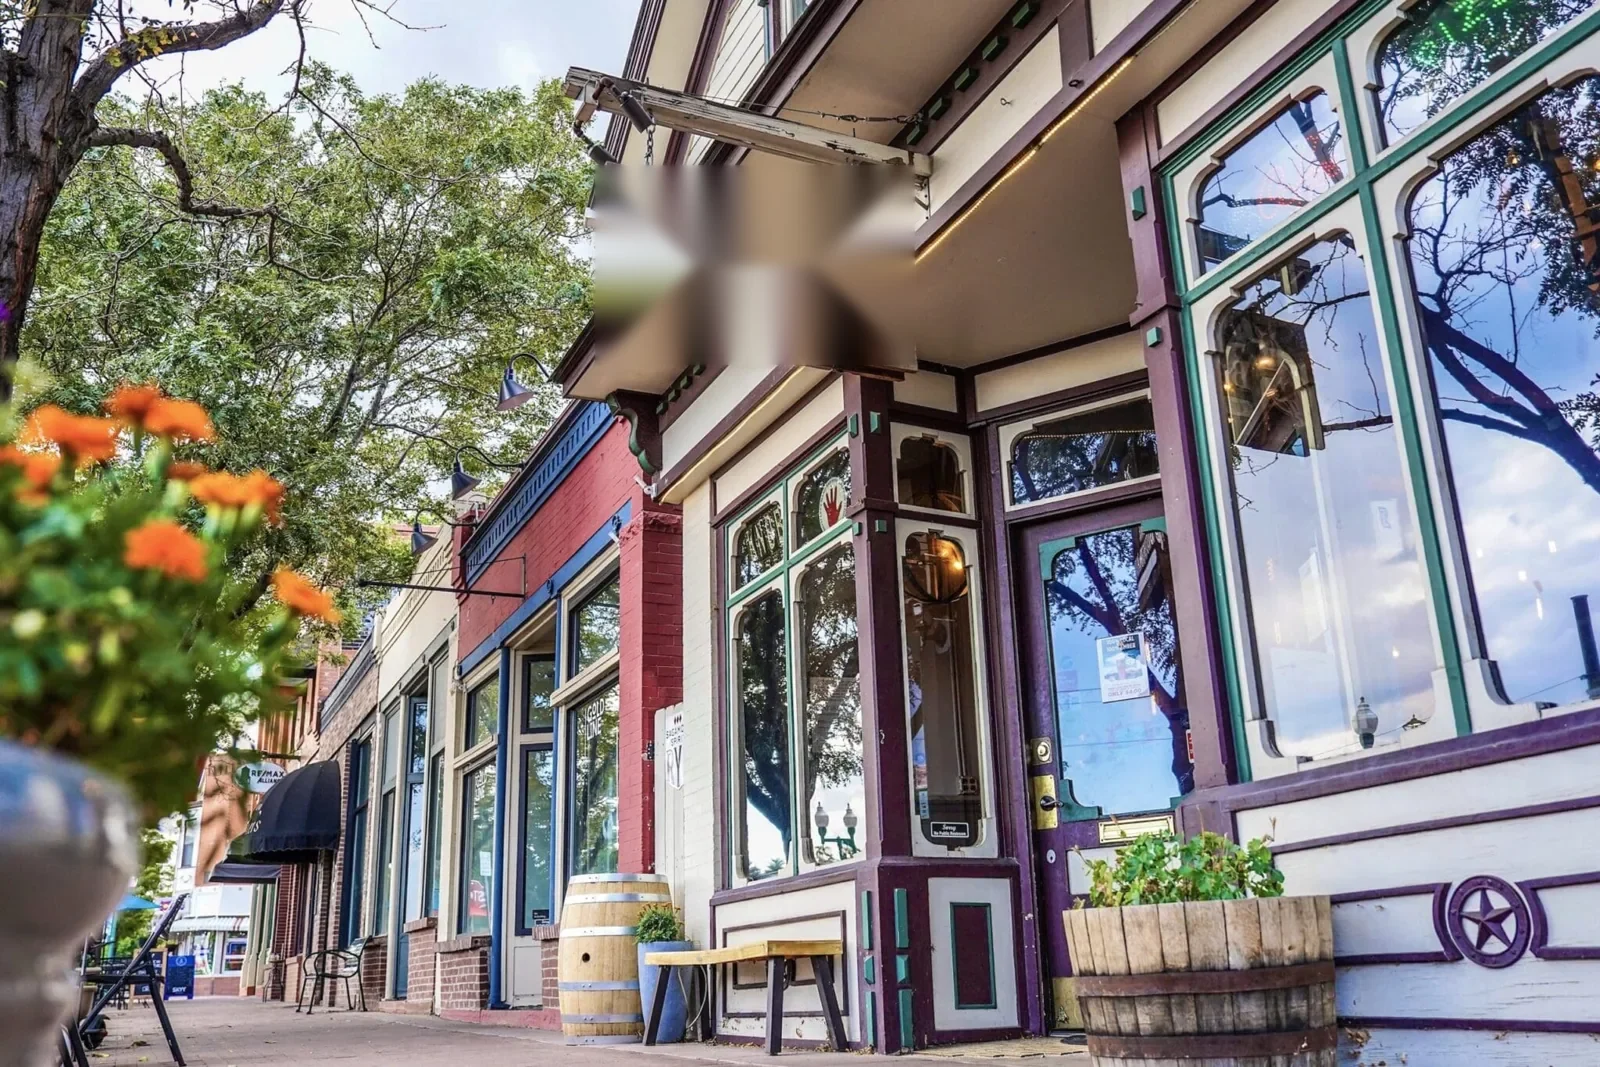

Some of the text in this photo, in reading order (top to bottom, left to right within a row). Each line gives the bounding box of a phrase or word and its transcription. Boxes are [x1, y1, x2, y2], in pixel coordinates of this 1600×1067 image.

[587, 698, 605, 722] GOLD
[587, 717, 602, 740] LINE
[251, 769, 284, 777] RE/MAX
